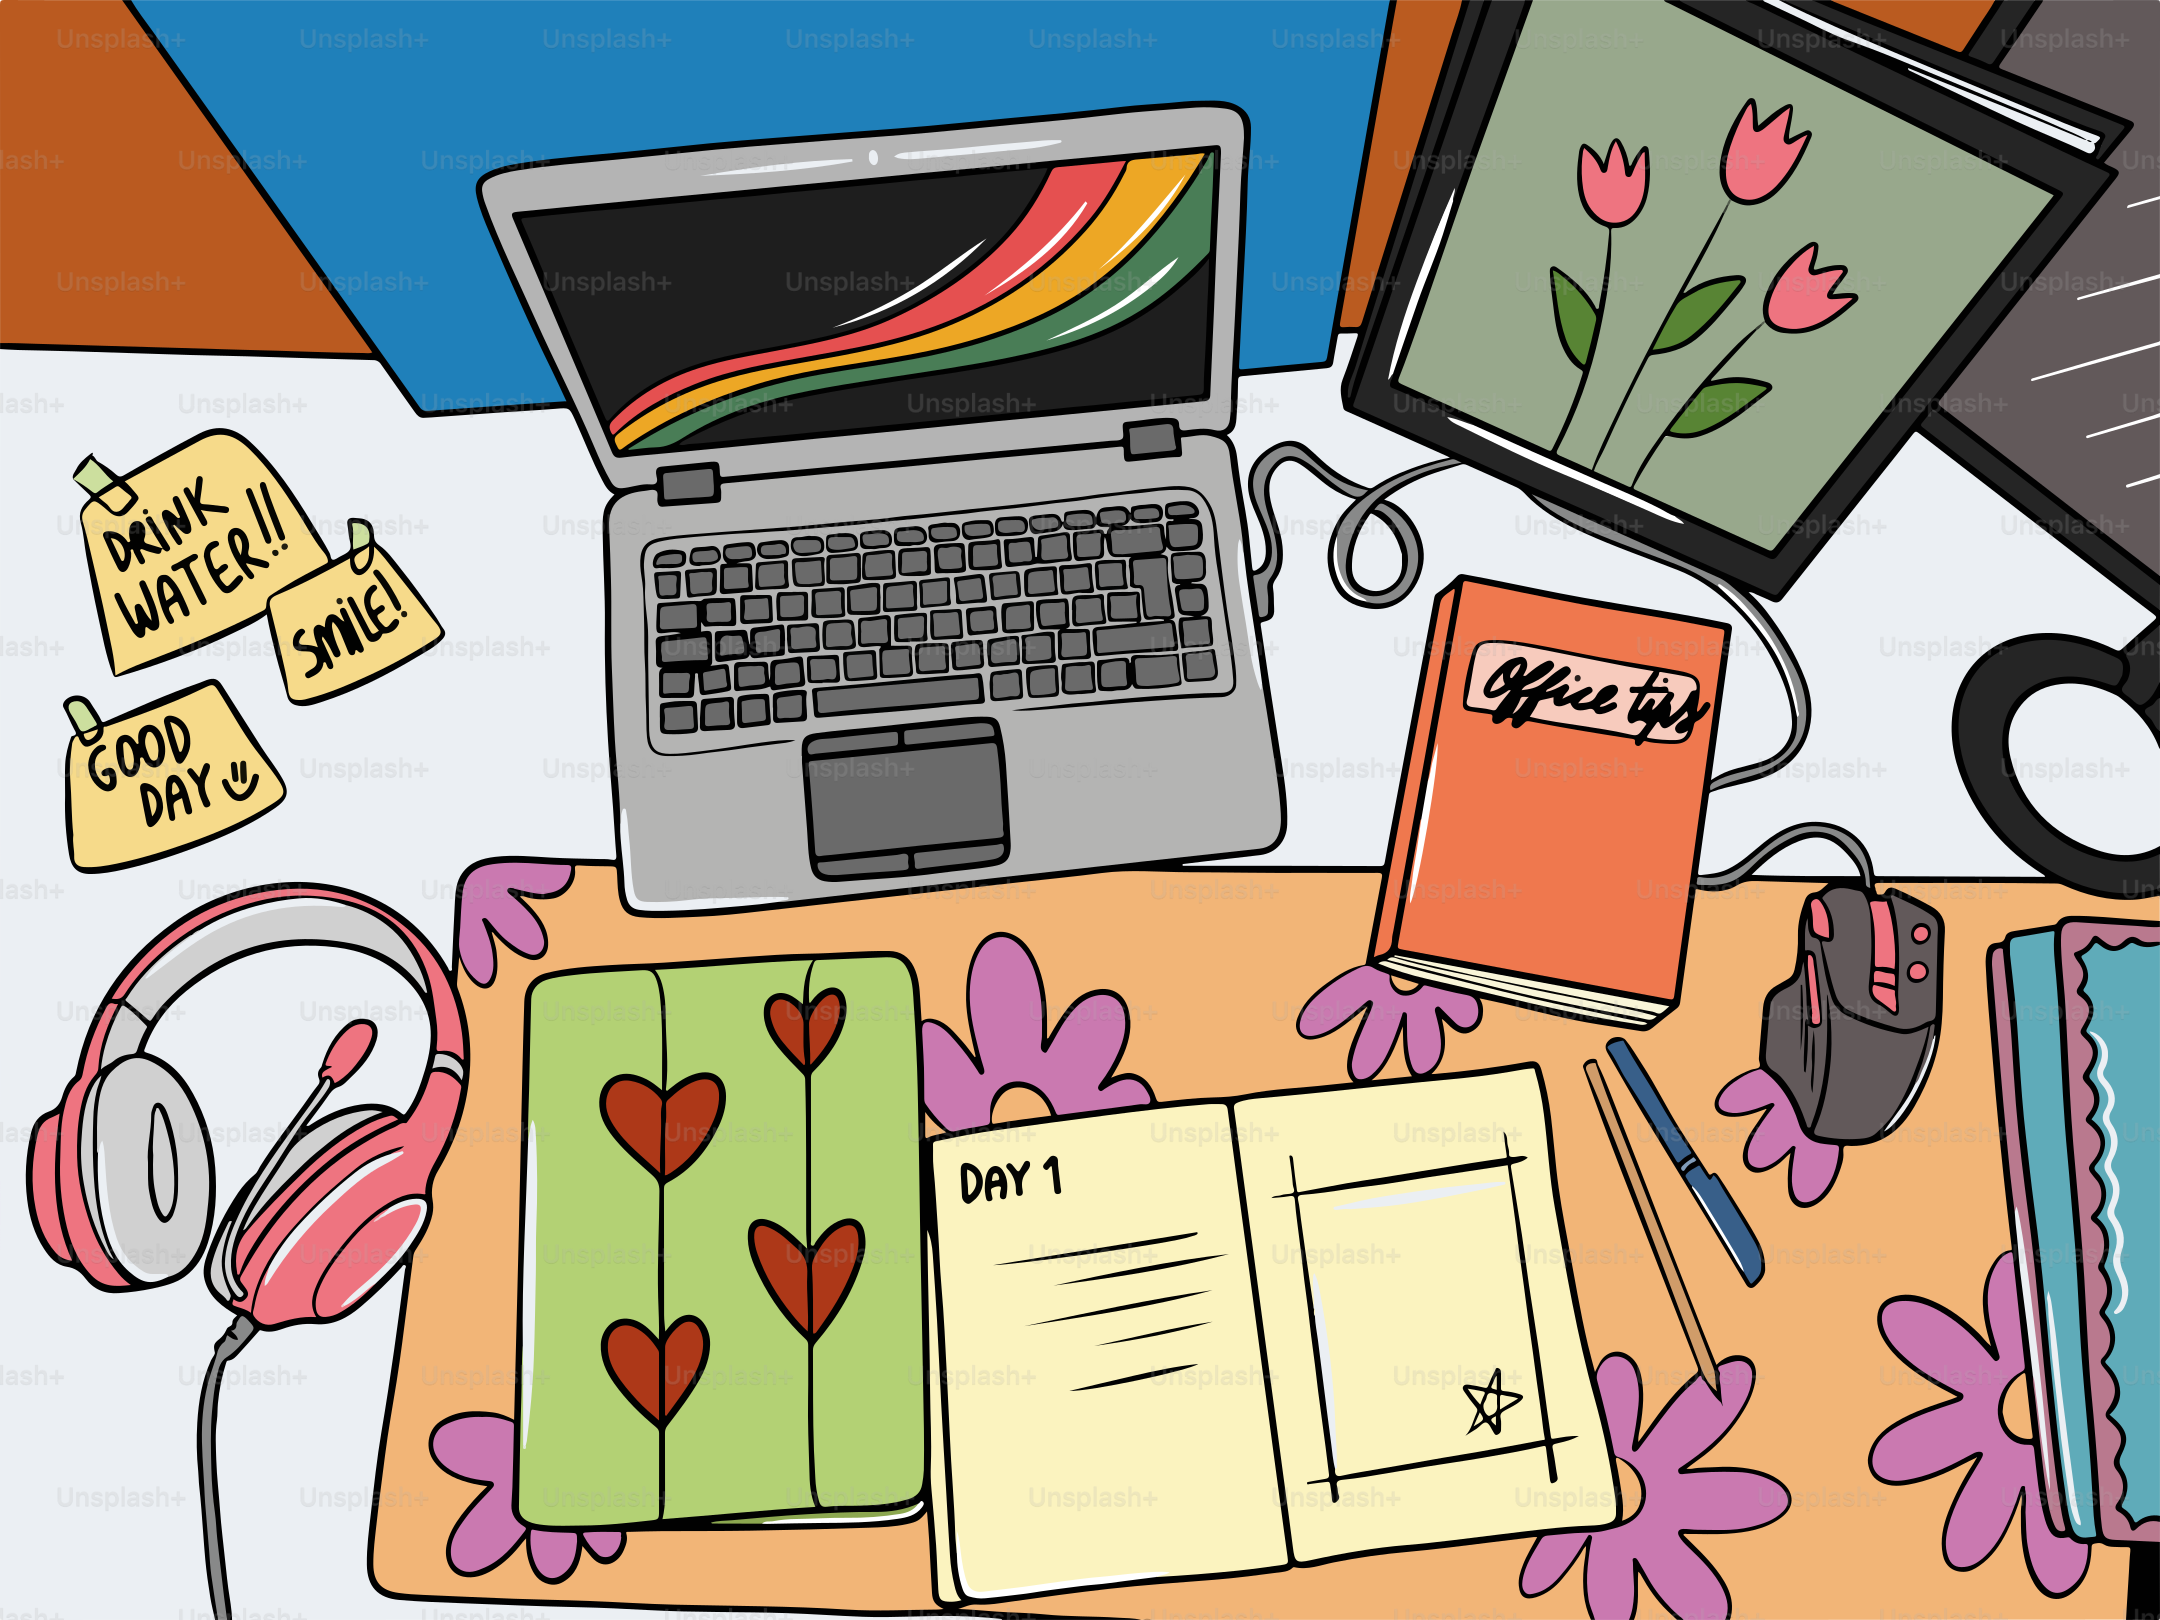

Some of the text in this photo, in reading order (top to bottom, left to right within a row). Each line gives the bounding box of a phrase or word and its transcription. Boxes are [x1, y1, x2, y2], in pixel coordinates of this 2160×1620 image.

[1483, 656, 1711, 746] Office tips
[88, 715, 191, 791] GOOD
[140, 762, 210, 827] DAY
[960, 1155, 1061, 1204] DAY 1
